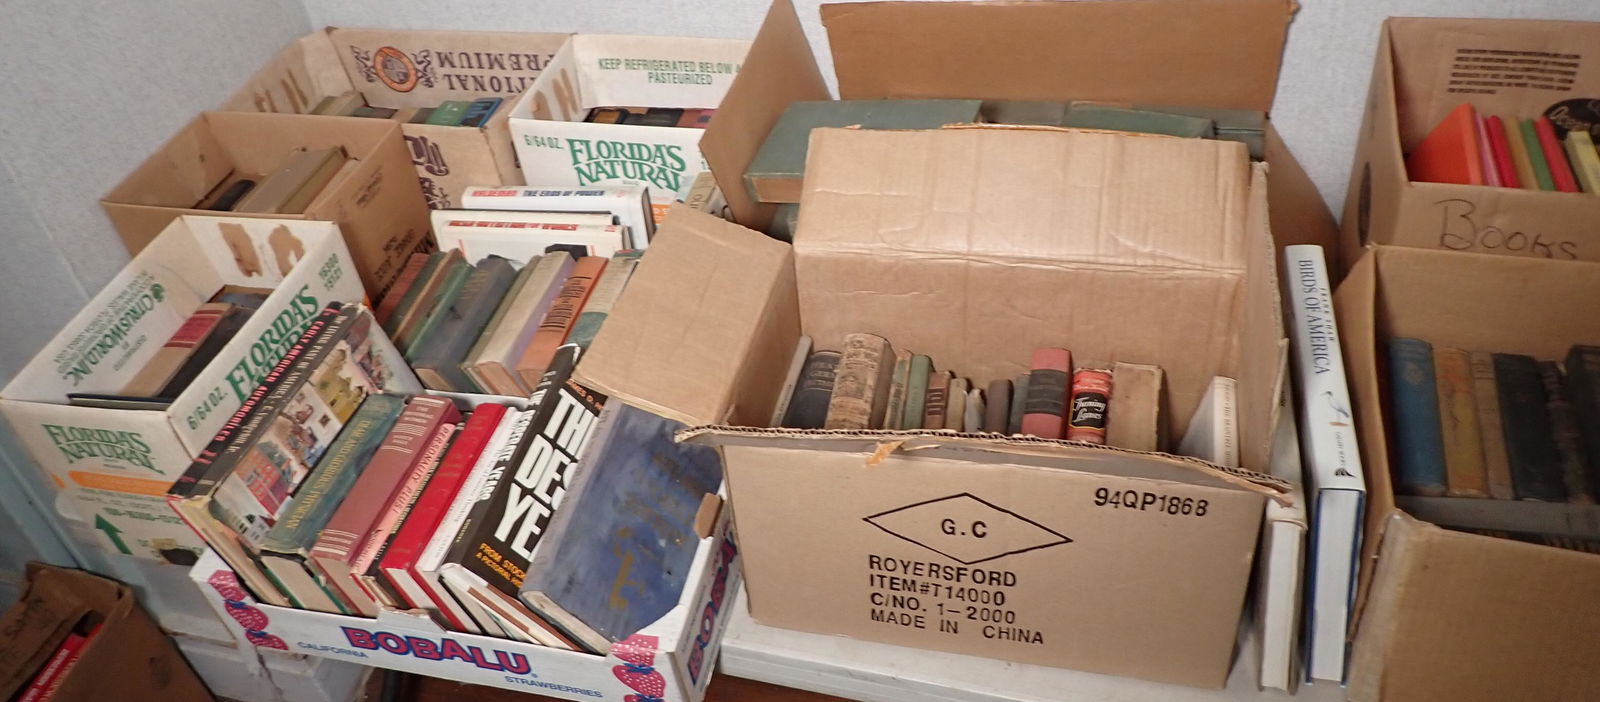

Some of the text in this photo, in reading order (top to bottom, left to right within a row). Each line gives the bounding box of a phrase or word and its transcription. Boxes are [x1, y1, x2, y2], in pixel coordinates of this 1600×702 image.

[599, 59, 732, 74] KEEP REFRIGERATED BELOW
[648, 72, 712, 85] PASTEURIZED
[575, 160, 681, 193] NATURAL
[1298, 259, 1331, 375] BIRDS OF AMERICA
[265, 342, 303, 384] AMERICAN
[543, 388, 599, 461] TH
[411, 424, 449, 484] PERSONALITY
[1094, 487, 1209, 517] 94QP1868
[495, 483, 551, 562] YE
[869, 554, 1017, 587] ROYERSFORD
[869, 574, 1006, 607] ITEM#T14000
[871, 608, 1044, 645] MADE IN CHINA
[297, 641, 369, 658] CALIFORNIA
[340, 626, 531, 675] BOBALU
[505, 676, 604, 698] STRAWBERRIES
